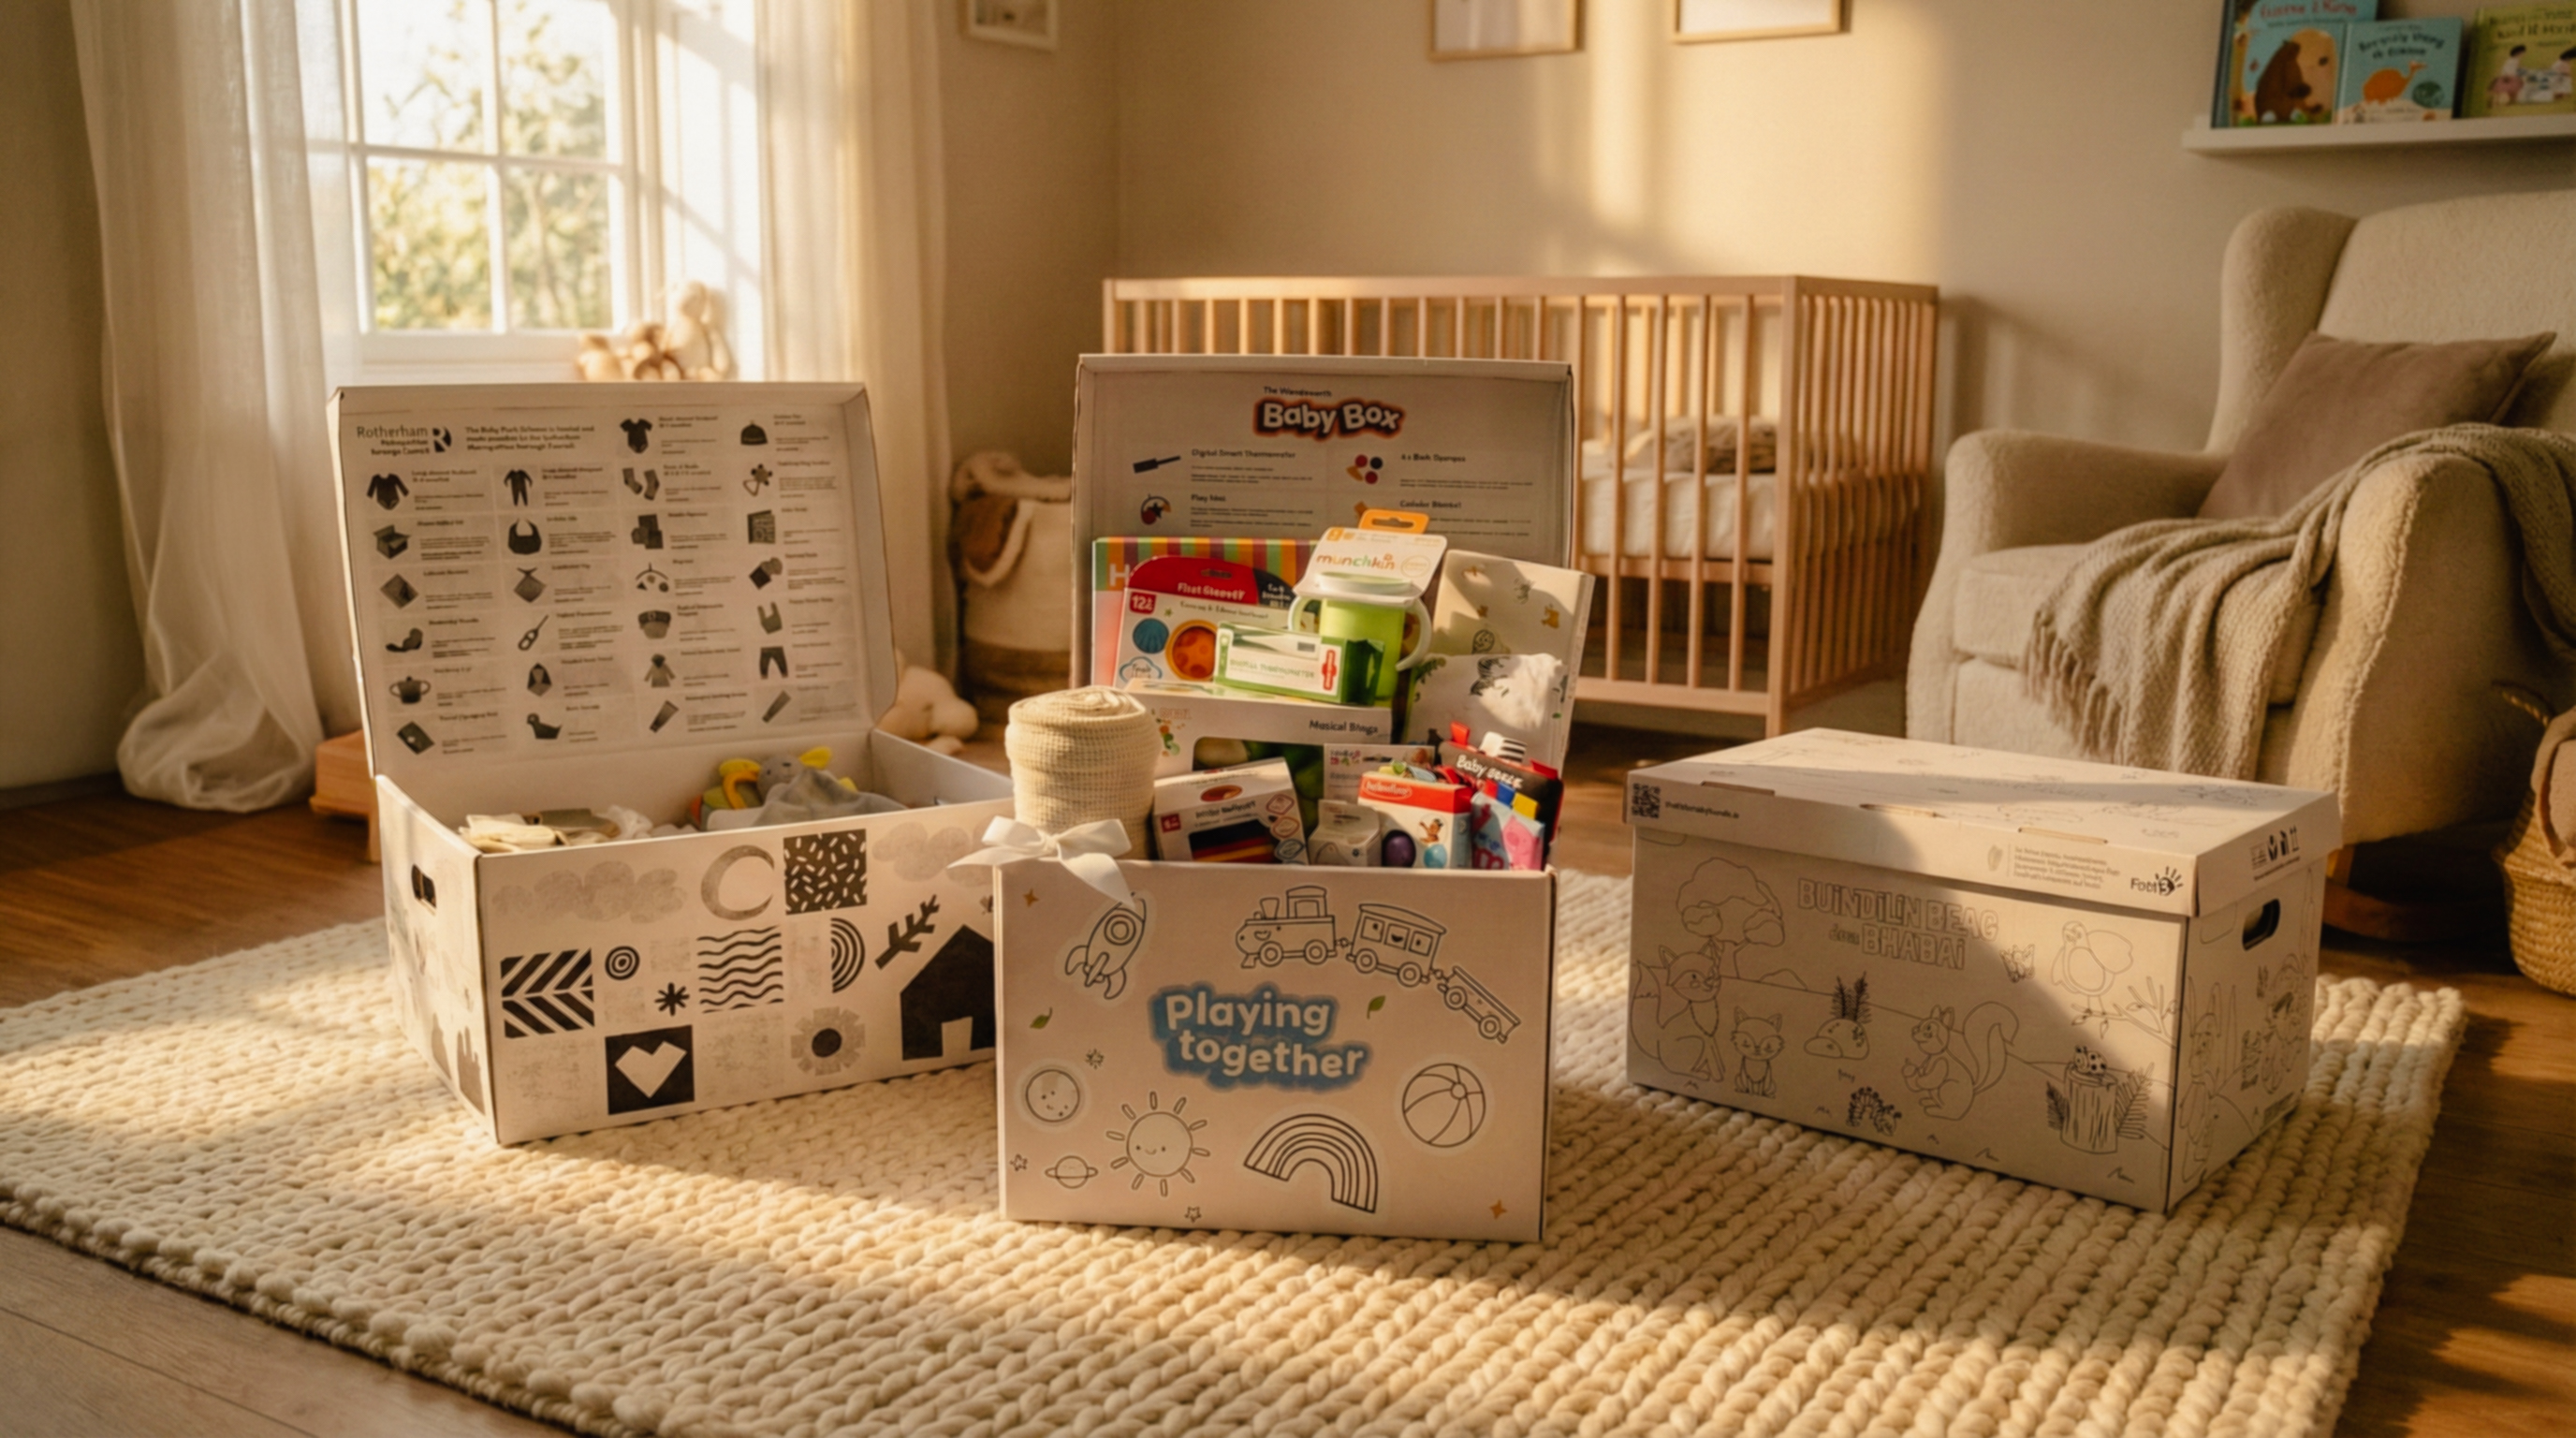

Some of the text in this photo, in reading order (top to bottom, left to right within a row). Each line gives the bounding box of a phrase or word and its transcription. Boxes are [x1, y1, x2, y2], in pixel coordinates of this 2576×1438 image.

[357, 424, 429, 438] Rotherham
[1263, 402, 1400, 434] Baby Box
[1317, 553, 1396, 571] munchkin
[1925, 899, 1999, 943] BEAG
[1165, 990, 1330, 1036] Playing
[1178, 1029, 1365, 1078] together
